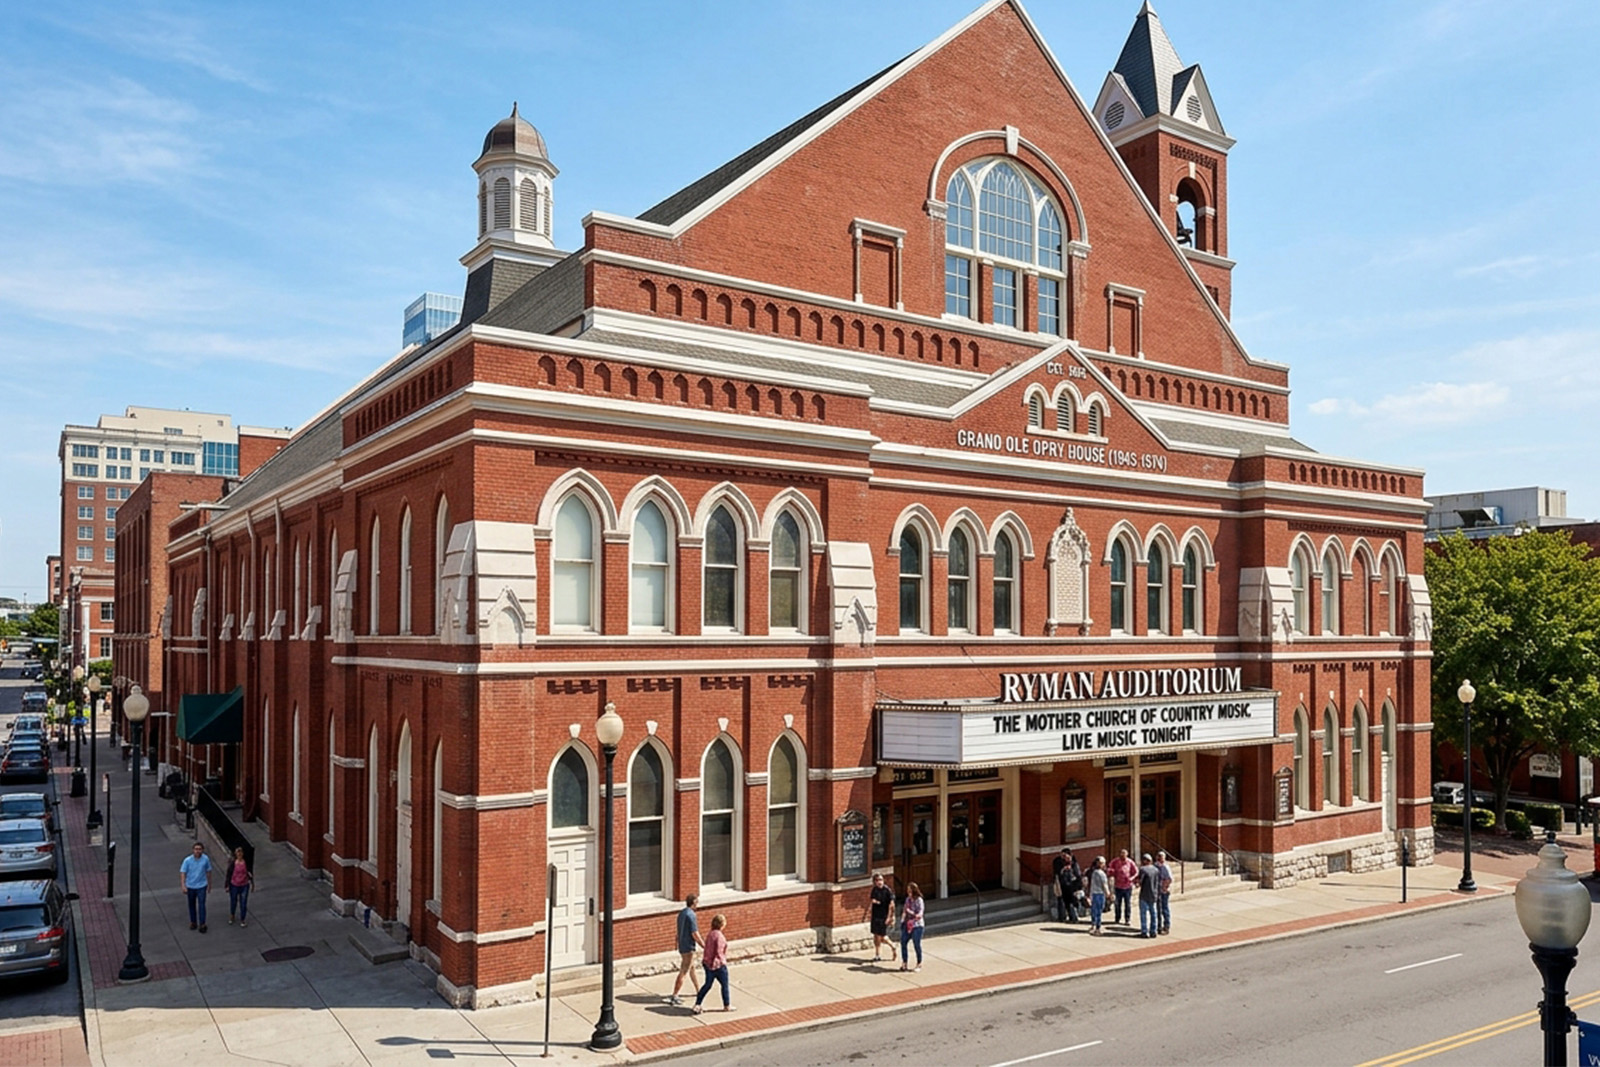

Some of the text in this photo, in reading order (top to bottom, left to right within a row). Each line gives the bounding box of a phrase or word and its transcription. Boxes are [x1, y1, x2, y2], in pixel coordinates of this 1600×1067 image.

[1005, 435, 1030, 454] OLE
[1032, 439, 1065, 458] OPRY
[1068, 443, 1106, 464] HOUSE
[1002, 666, 1243, 703] RYMAN AUDITORIUM
[993, 714, 1021, 733] THE
[1025, 712, 1082, 732] MOTHER
[1085, 709, 1137, 728] CHURCH
[1140, 708, 1157, 724] OF
[1160, 704, 1215, 723] COUNTRY
[1062, 725, 1193, 751] LIVE MUSIC TONIGHT
